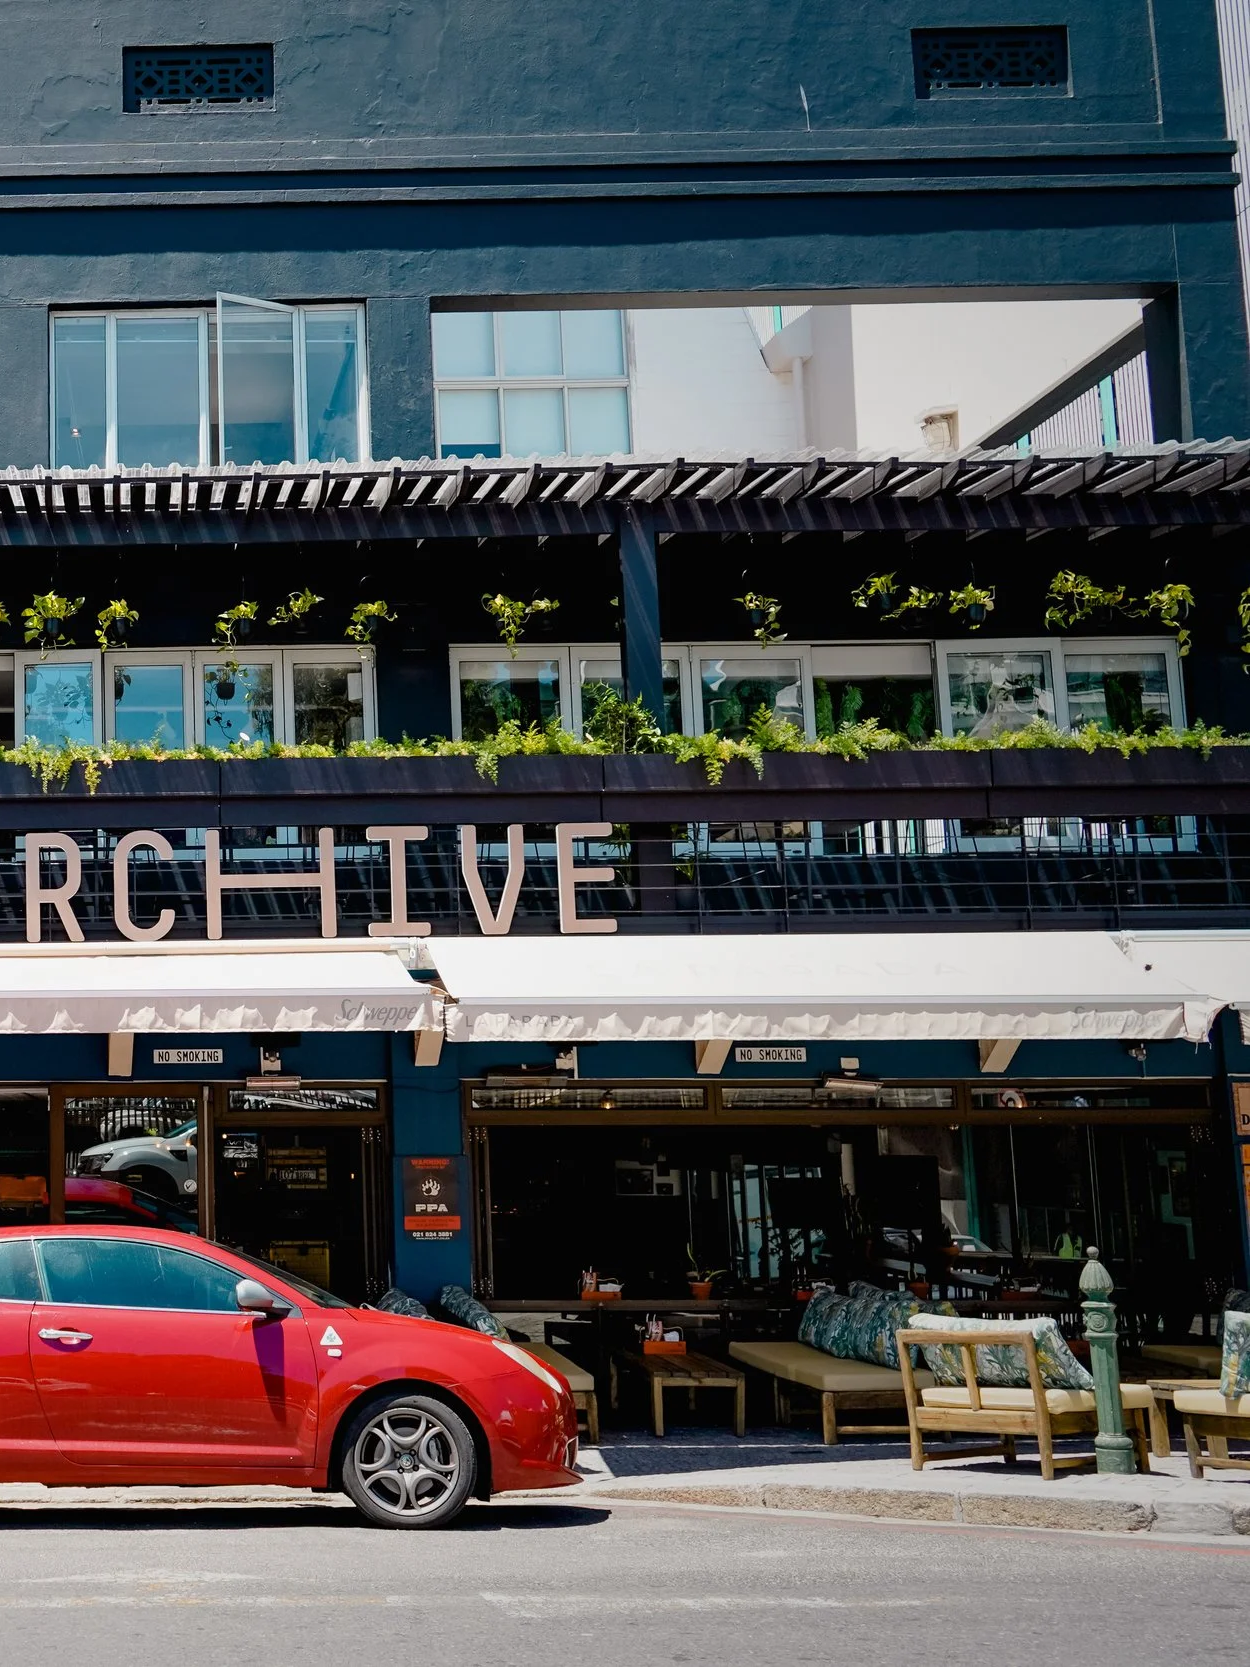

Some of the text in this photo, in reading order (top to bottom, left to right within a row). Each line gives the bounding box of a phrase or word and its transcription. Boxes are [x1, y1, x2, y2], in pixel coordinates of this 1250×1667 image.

[334, 998, 418, 1026] Schweppe
[465, 1014, 576, 1028] LA PARADA
[158, 1050, 219, 1062] NO SMOKING
[740, 1048, 803, 1061] NO SMOKING
[415, 1203, 448, 1212] PPA
